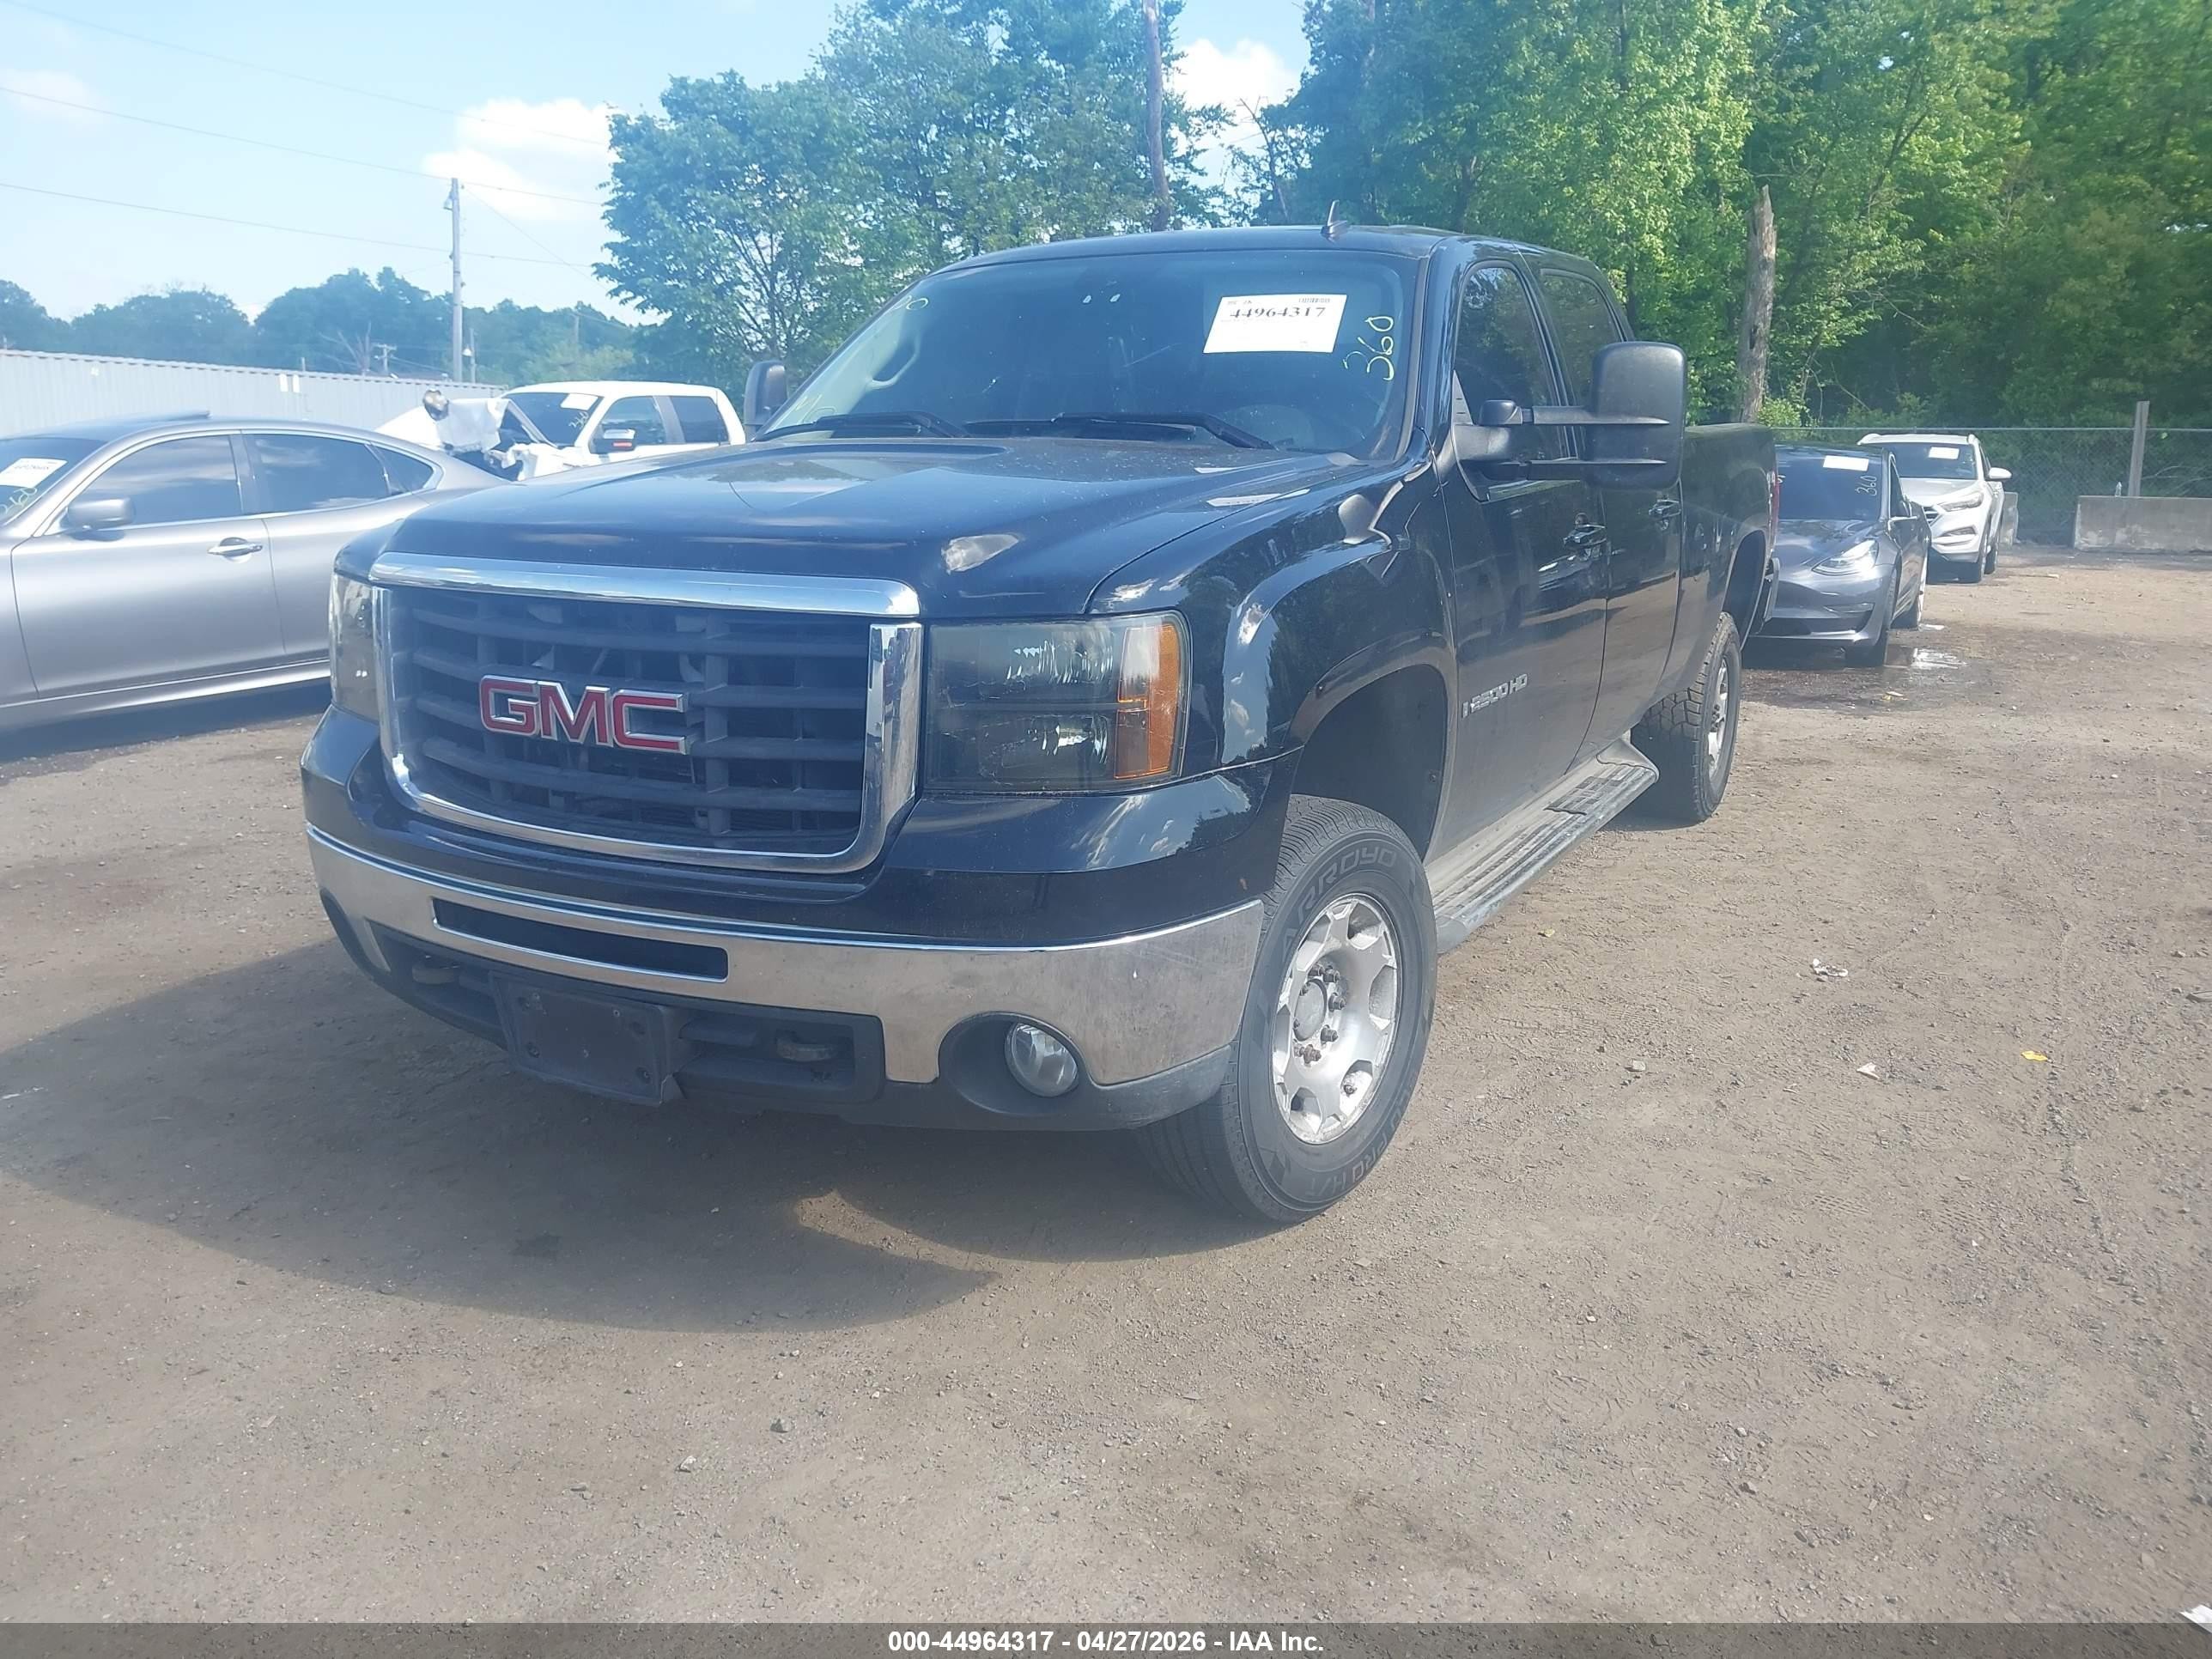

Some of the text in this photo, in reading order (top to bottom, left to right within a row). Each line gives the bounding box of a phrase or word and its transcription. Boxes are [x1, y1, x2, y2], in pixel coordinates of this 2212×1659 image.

[1229, 307, 1328, 319] 44964317
[1342, 315, 1395, 380] 360
[1854, 475, 1877, 496] 360
[480, 675, 686, 755] GMC
[1281, 845, 1398, 962] ARROYO
[1352, 1131, 1388, 1184] PRO
